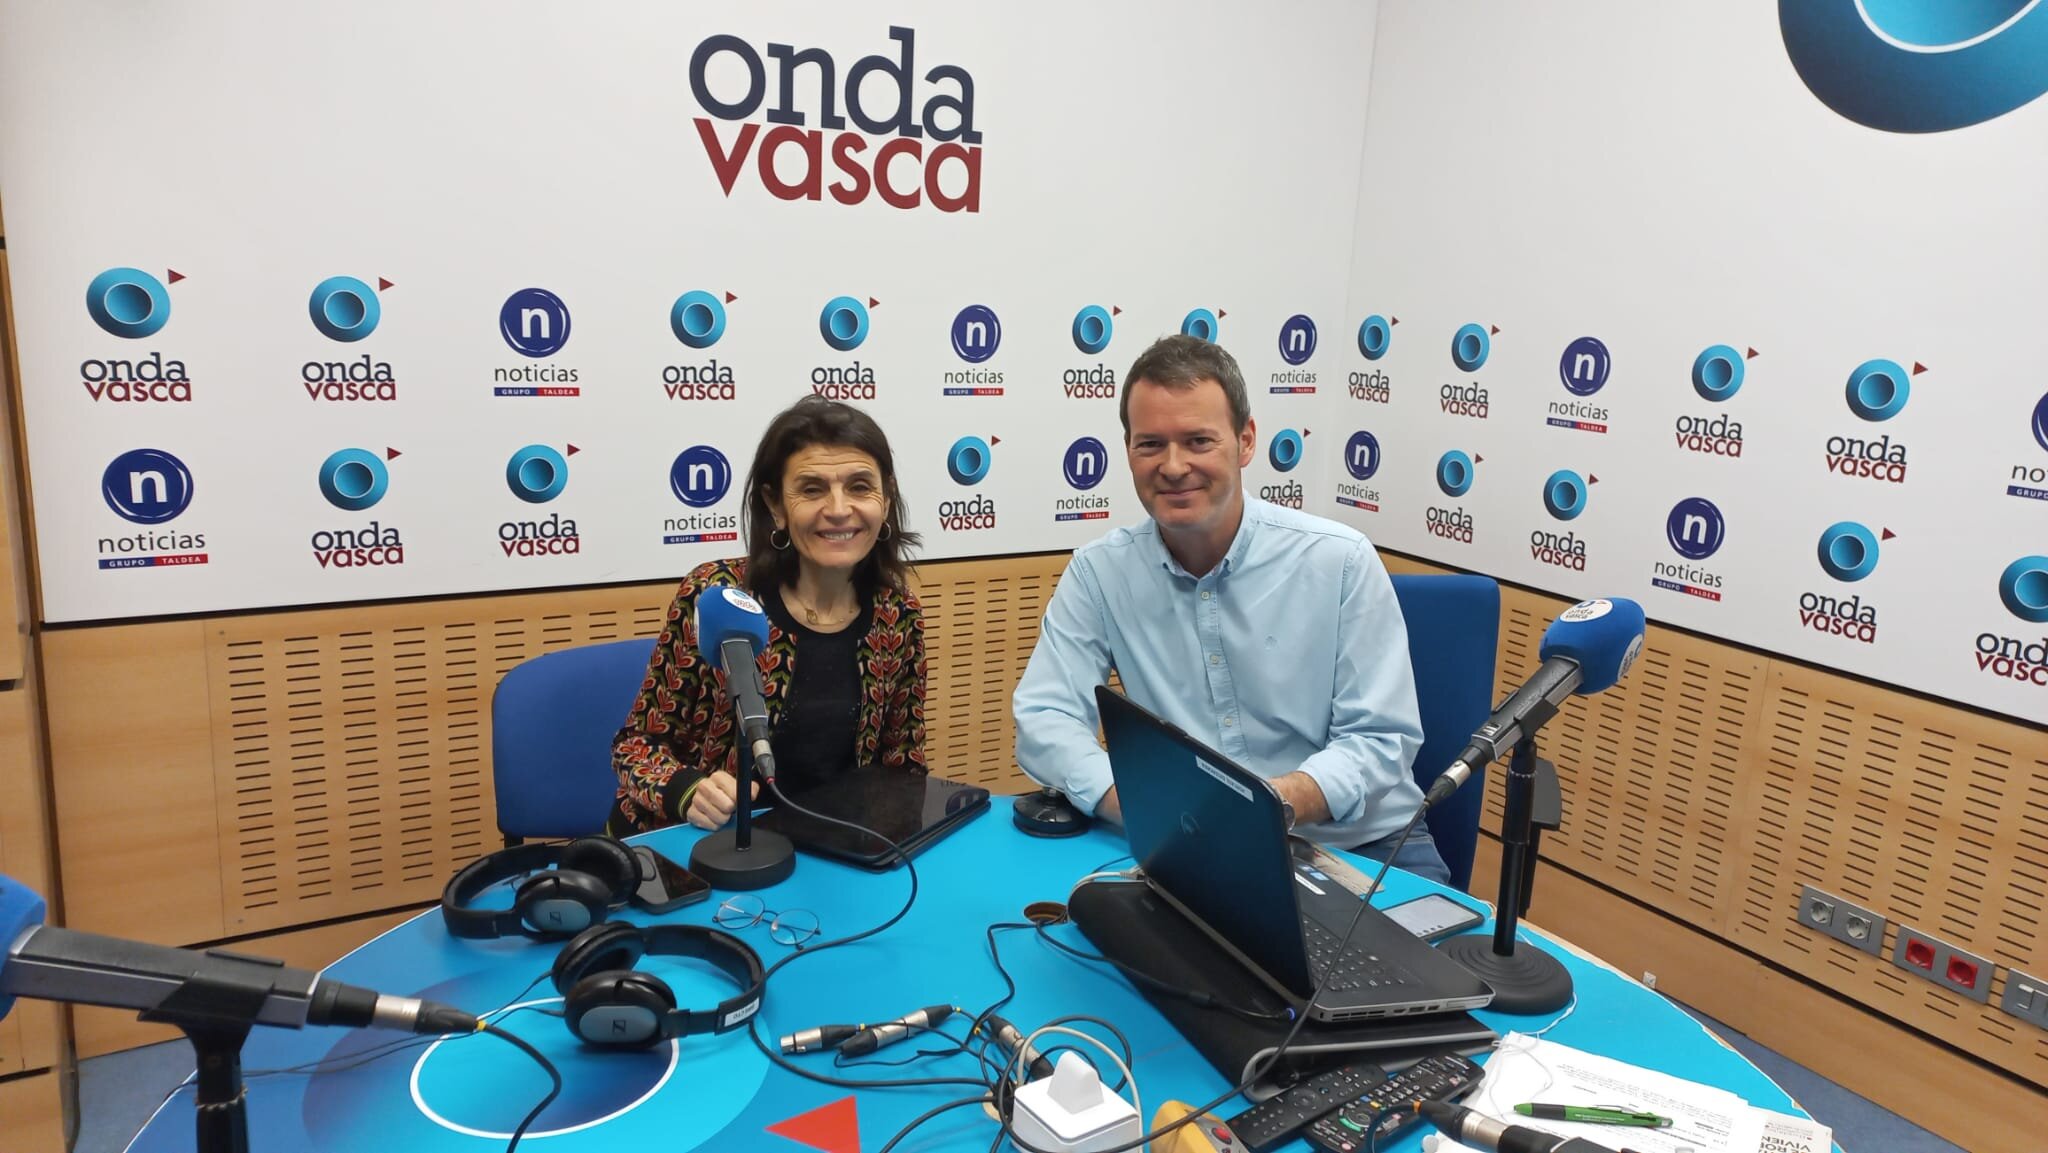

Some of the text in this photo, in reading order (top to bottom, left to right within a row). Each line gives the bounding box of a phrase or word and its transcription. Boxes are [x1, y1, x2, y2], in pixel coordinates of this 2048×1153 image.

[689, 25, 983, 145] onda
[692, 117, 983, 214] vasca
[522, 309, 549, 338] n
[966, 322, 986, 346] n
[1290, 330, 1305, 351] n
[80, 352, 190, 383] onda
[302, 354, 395, 383] onda
[494, 364, 579, 382] noticias
[663, 359, 735, 384] onda
[811, 360, 876, 385] onda
[944, 368, 1004, 383] noticias
[1063, 363, 1116, 385] onda
[1270, 370, 1316, 384] noticias
[1574, 354, 1595, 380] n
[1349, 369, 1390, 389] onda
[84, 380, 192, 402] vasca
[304, 381, 397, 401] vasca
[664, 383, 736, 401] vasca
[812, 383, 876, 401] vasca
[1064, 383, 1116, 399] vasca
[1349, 384, 1390, 403] vasca
[1440, 381, 1489, 404] onda
[1441, 398, 1489, 419] vasca
[1549, 401, 1608, 421] noticias
[1676, 414, 1743, 441] onda
[1354, 444, 1370, 467] n
[1676, 432, 1743, 458] vasca
[1826, 435, 1907, 465] onda
[1076, 453, 1094, 475] n
[1826, 454, 1906, 484] vasca
[130, 471, 167, 503] n
[689, 464, 712, 490] n
[1260, 480, 1303, 500] onda
[1337, 483, 1380, 502] noticias
[939, 494, 995, 517] onda
[1056, 494, 1110, 510] noticias
[499, 513, 578, 541] onda
[664, 512, 736, 531] noticias
[940, 513, 996, 532] vasca
[1426, 507, 1473, 530] onda
[1683, 514, 1706, 543] n
[98, 530, 206, 553] noticias
[312, 521, 402, 551] onda
[1426, 521, 1473, 545] vasca
[1531, 530, 1586, 557] onda
[314, 546, 404, 569] vasca
[500, 536, 580, 557] vasca
[109, 556, 201, 567] GRUPO TALDEA
[1531, 545, 1586, 572] vasca
[1654, 561, 1723, 588] noticias
[1657, 580, 1717, 599] GRUPO TALDEA
[1800, 592, 1877, 626] onda
[1800, 609, 1877, 644] vasca
[1976, 632, 2048, 667] ond
[1975, 651, 2048, 686] vasc
[1761, 1135, 1811, 1153] VIVIEN
